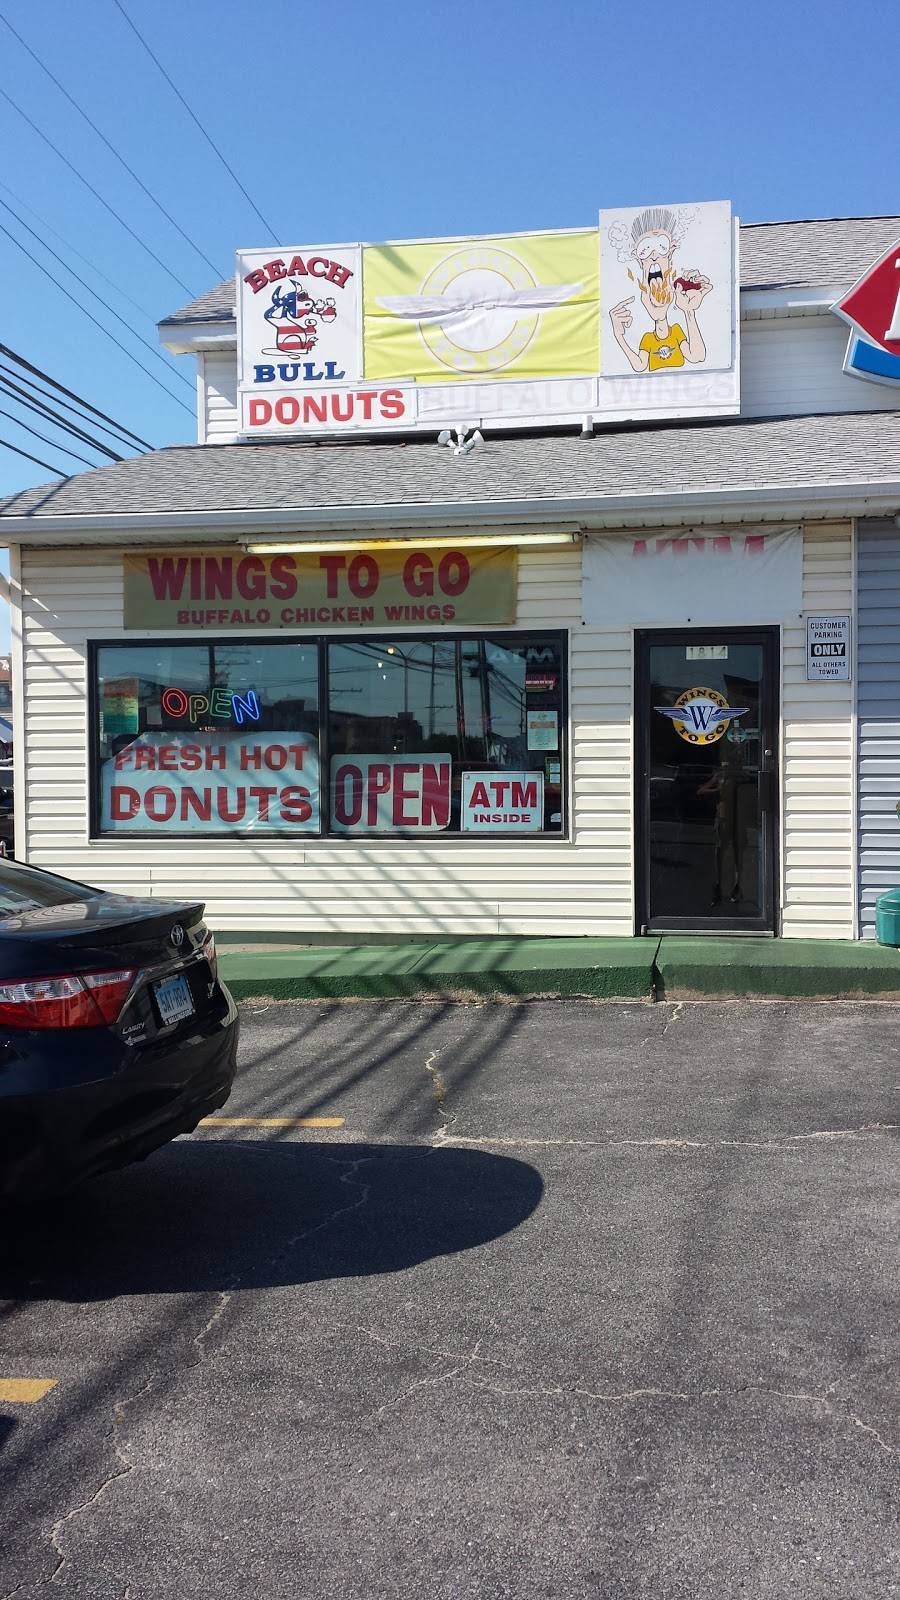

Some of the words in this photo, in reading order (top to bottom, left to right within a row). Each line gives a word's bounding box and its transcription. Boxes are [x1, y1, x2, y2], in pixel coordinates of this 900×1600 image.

[244, 255, 354, 294] BEACH
[253, 361, 346, 383] BULL
[249, 389, 405, 426] DONUTS
[148, 555, 298, 600] WINGS
[320, 554, 379, 598] TO
[403, 552, 470, 597] GO
[177, 608, 270, 625] BUFFALO
[281, 606, 374, 623] CHICKEN
[384, 604, 456, 621] WINGS
[811, 621, 846, 630] CUSTOMER
[690, 646, 727, 658] 1814
[813, 644, 843, 656] ONLY
[162, 687, 260, 724] OPEN
[678, 689, 726, 708] WINGS
[687, 705, 716, 731] W
[679, 725, 699, 741] TO
[705, 724, 725, 741] GO
[114, 744, 226, 771] FRESH
[239, 744, 309, 771] HOT
[110, 785, 313, 822] DONUTS
[334, 763, 450, 826] OPEN
[468, 781, 537, 808] ATM
[473, 813, 531, 823] INSIDE
